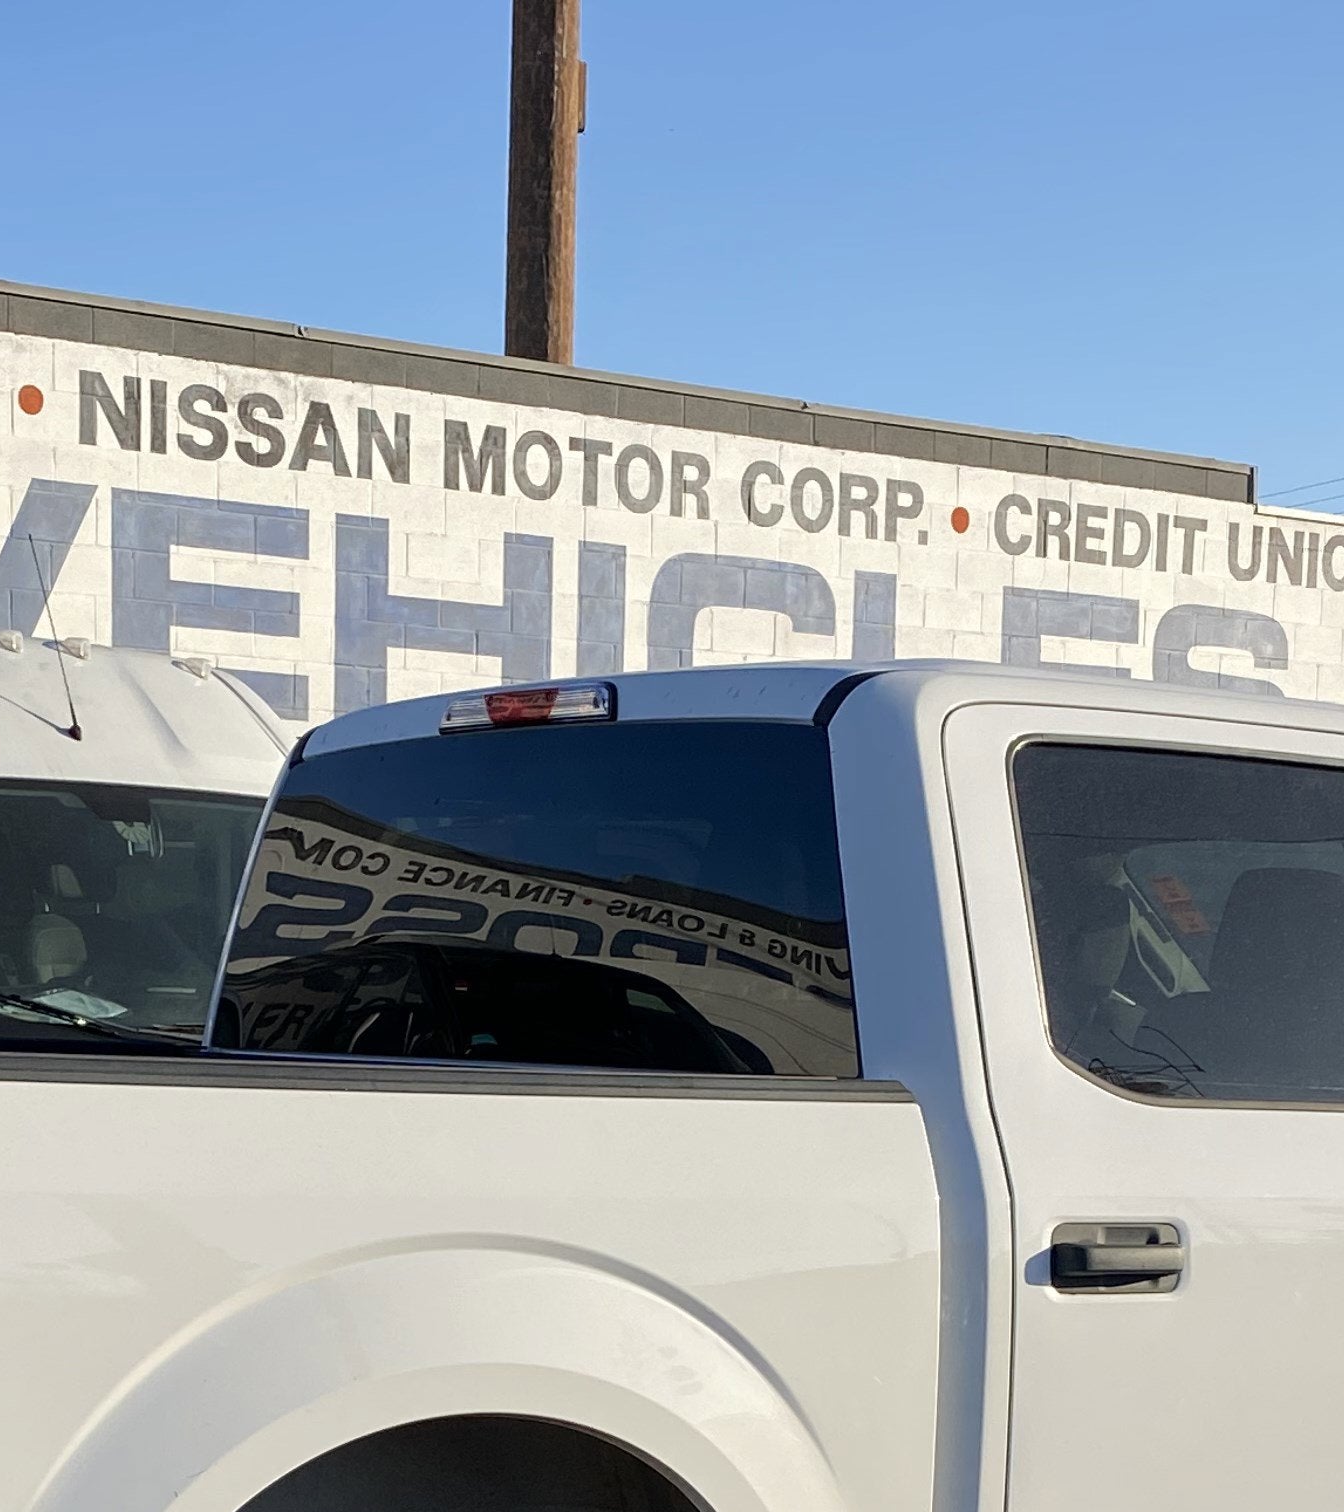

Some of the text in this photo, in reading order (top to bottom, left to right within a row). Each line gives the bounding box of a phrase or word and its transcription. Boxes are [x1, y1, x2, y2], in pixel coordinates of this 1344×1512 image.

[78, 369, 412, 486] NISSAN
[444, 418, 711, 520] MOTOR
[741, 459, 929, 546] CORP.
[994, 494, 1209, 576] CREDIT
